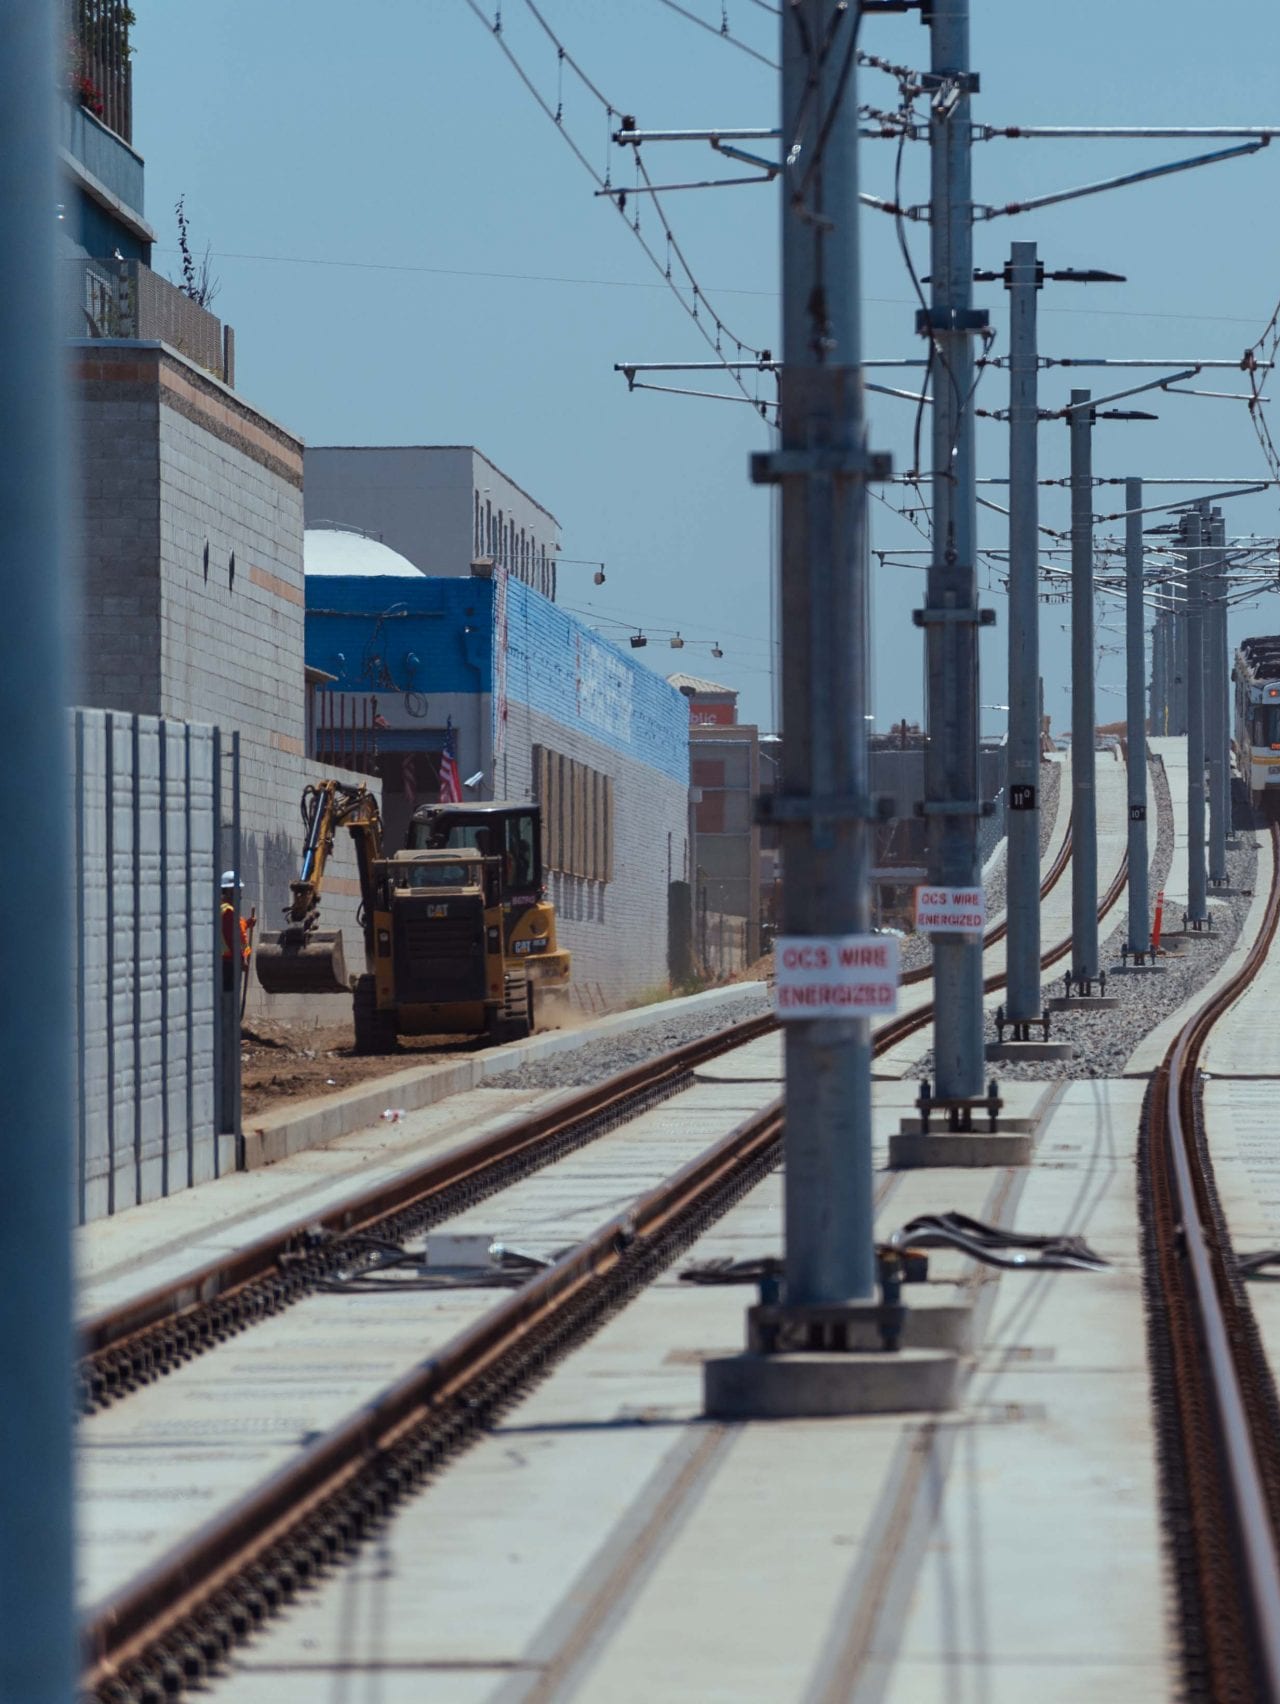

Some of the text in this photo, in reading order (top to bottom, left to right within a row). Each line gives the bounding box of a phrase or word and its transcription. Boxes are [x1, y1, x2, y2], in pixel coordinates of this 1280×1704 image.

[921, 893, 978, 905] OCS WIRE
[427, 904, 448, 918] CAT
[918, 914, 981, 926] ENERGIZED
[515, 941, 531, 953] CAT
[783, 945, 888, 969] OCS WIRE
[779, 984, 895, 1008] ENERGIZED
